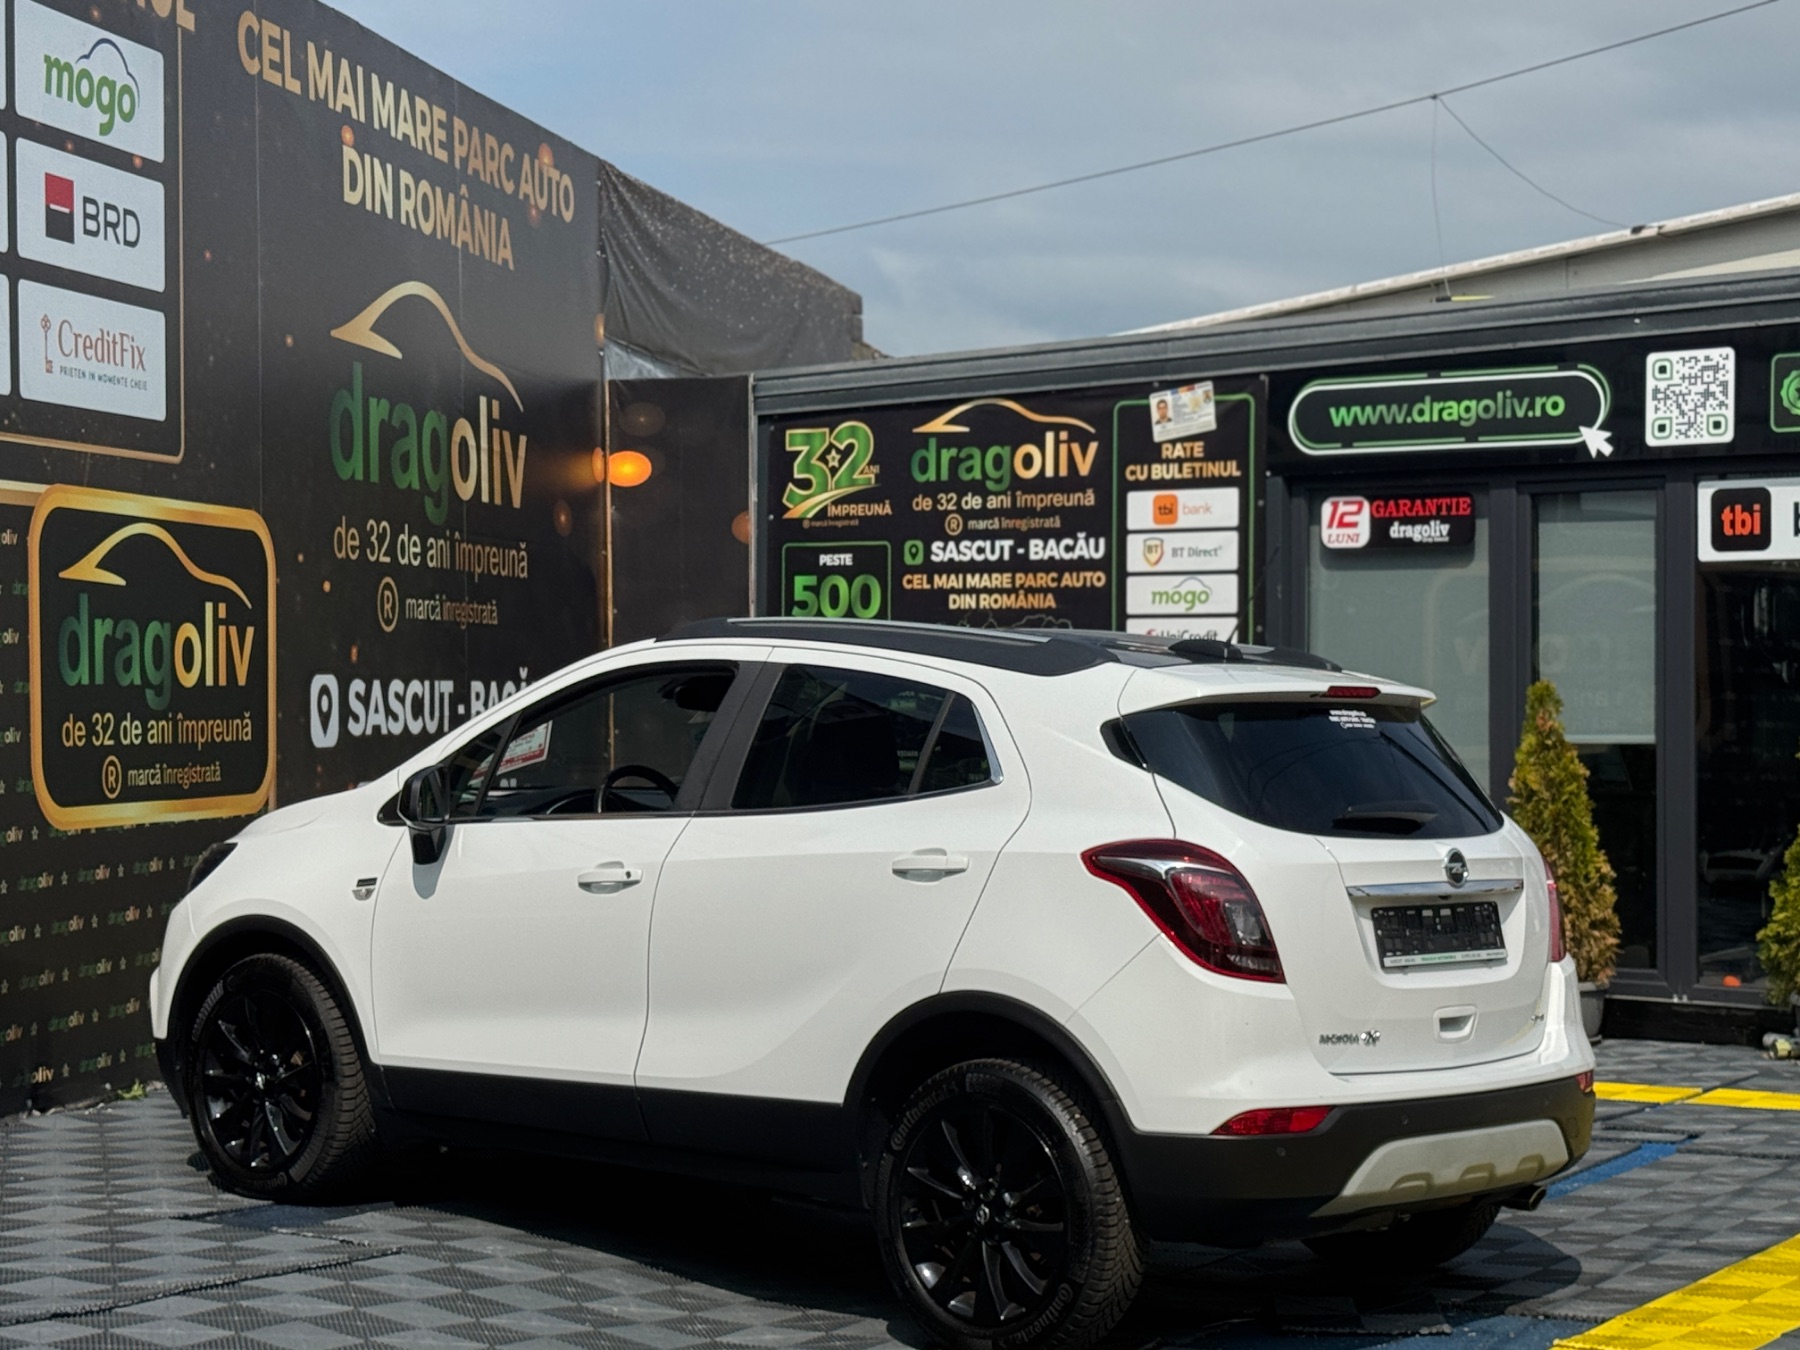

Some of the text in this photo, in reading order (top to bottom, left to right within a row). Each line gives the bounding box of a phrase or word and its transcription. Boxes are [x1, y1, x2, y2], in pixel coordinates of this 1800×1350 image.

[43, 54, 136, 136] mogo
[238, 10, 575, 223] CEL MAI MARE PARC AUTO
[82, 196, 140, 248] BRD
[342, 144, 514, 271] DIN ROMÂNIA
[58, 319, 146, 372] CreditFix
[1329, 389, 1565, 428] www.dragoliv.ro
[330, 361, 527, 525] dragoliv
[1161, 441, 1205, 460] RATE
[911, 431, 1099, 492] dragoliv
[1125, 460, 1241, 481] CU BULETINUL
[912, 488, 1095, 512] de 32 de ani împreună
[1158, 503, 1212, 516] tbi bank
[1327, 500, 1364, 529] 12
[1371, 497, 1472, 518] GARANTIE
[1389, 520, 1450, 542] dragoliv
[1721, 503, 1761, 536] tbi
[333, 516, 528, 583] de 32 de ani împreună
[930, 539, 1014, 562] SASCUT
[1028, 532, 1106, 561] BACĂU
[1171, 547, 1185, 558] BT
[1327, 533, 1360, 544] LUNI
[819, 553, 853, 566] PESTE
[902, 571, 1106, 589] CEL MAI MARE PARC AUTO
[405, 594, 441, 621] marcă
[791, 574, 881, 619] 500
[948, 590, 1056, 610] DIN ROMÂNIA
[1151, 589, 1210, 612] mogo
[58, 593, 255, 711] dragoliv
[347, 678, 454, 737] SASCUT
[62, 711, 252, 751] de 32 de ani împreună
[128, 764, 161, 787] marcă
